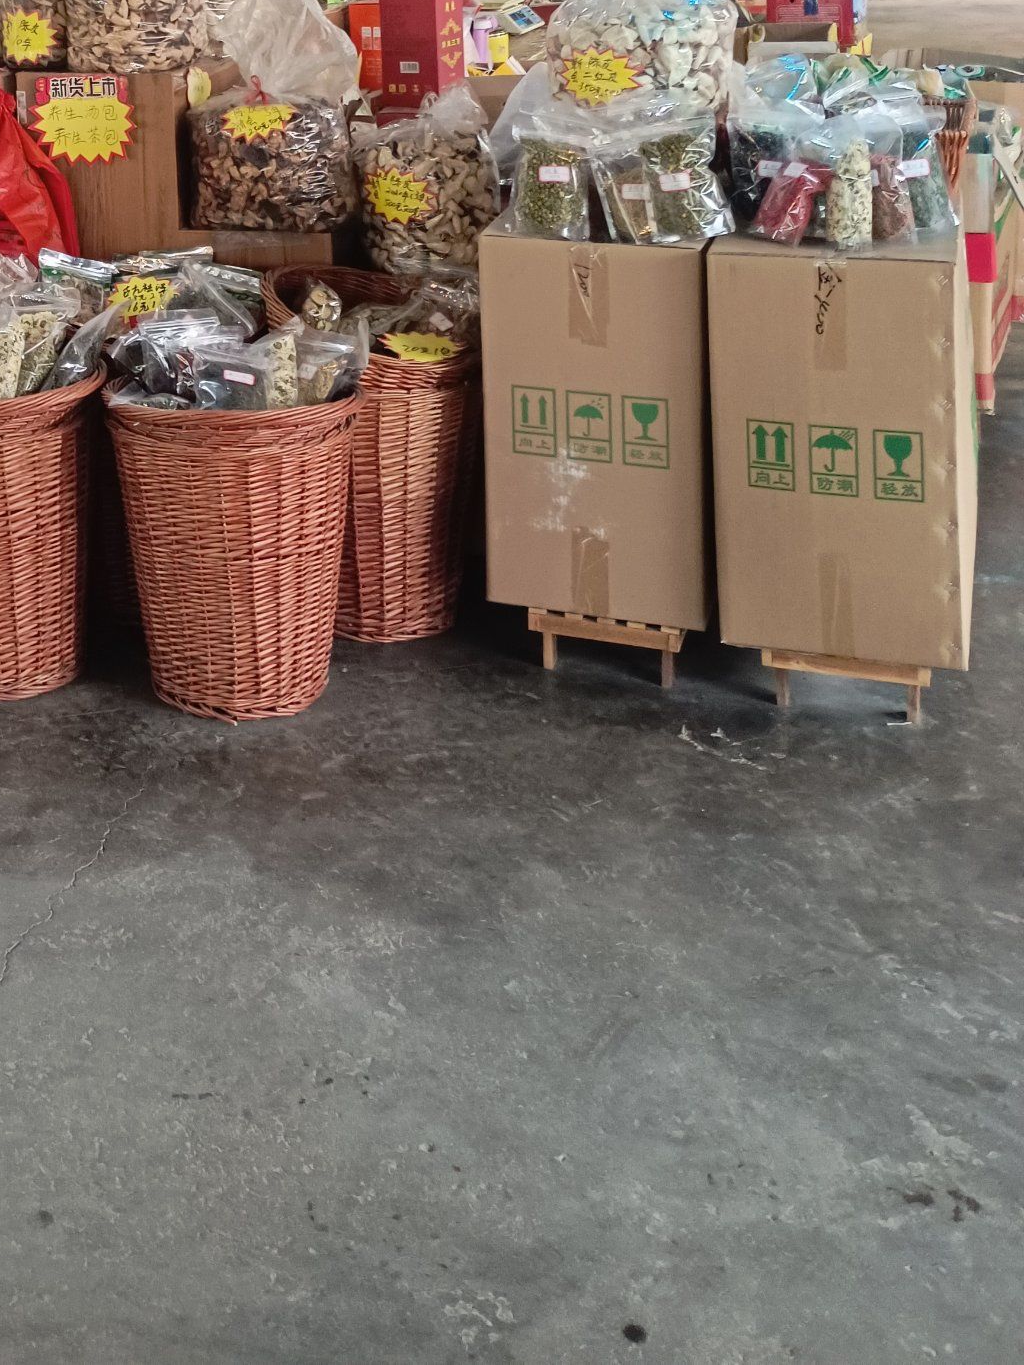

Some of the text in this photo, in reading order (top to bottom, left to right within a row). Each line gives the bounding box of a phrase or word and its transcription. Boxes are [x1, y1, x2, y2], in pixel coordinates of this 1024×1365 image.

[51, 77, 116, 98] 新货上市
[518, 437, 552, 451] 向上
[755, 470, 792, 487] 向上
[816, 476, 855, 494] 防潮
[880, 482, 920, 499] 轻放
